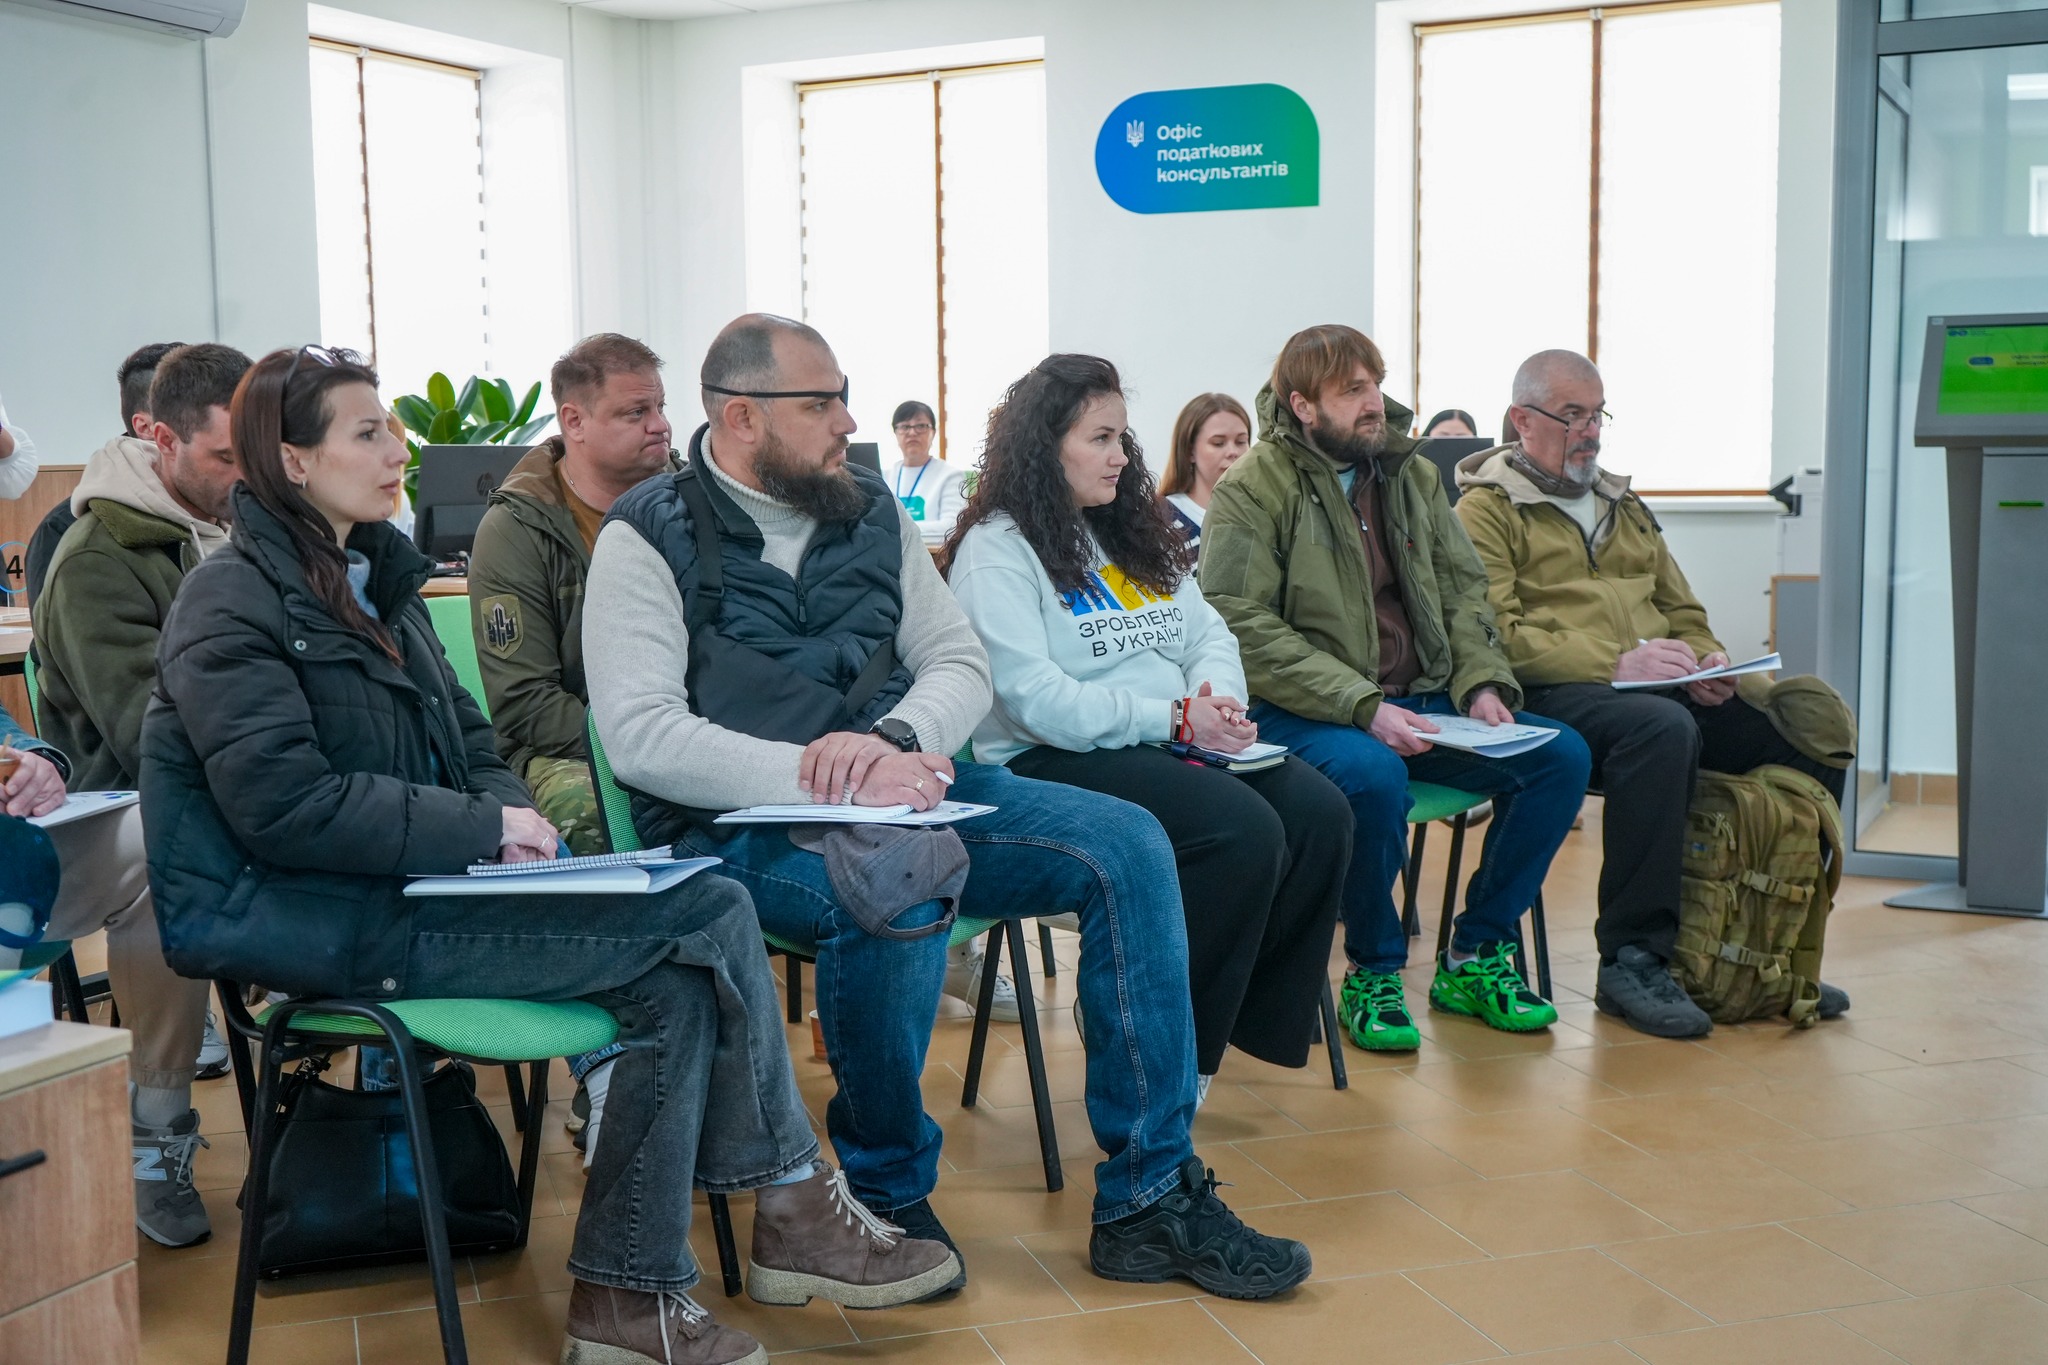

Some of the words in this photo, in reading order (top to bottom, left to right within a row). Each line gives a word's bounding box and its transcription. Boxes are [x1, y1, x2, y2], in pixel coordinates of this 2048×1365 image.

[1156, 123, 1203, 142] Офіс
[1157, 143, 1264, 162] податкових
[1157, 161, 1289, 184] консультантів
[6, 555, 23, 579] 4
[1078, 607, 1183, 638] ЗРОБЛЕНО
[1092, 640, 1108, 657] В
[1113, 625, 1184, 652] УКРАЇНІ
